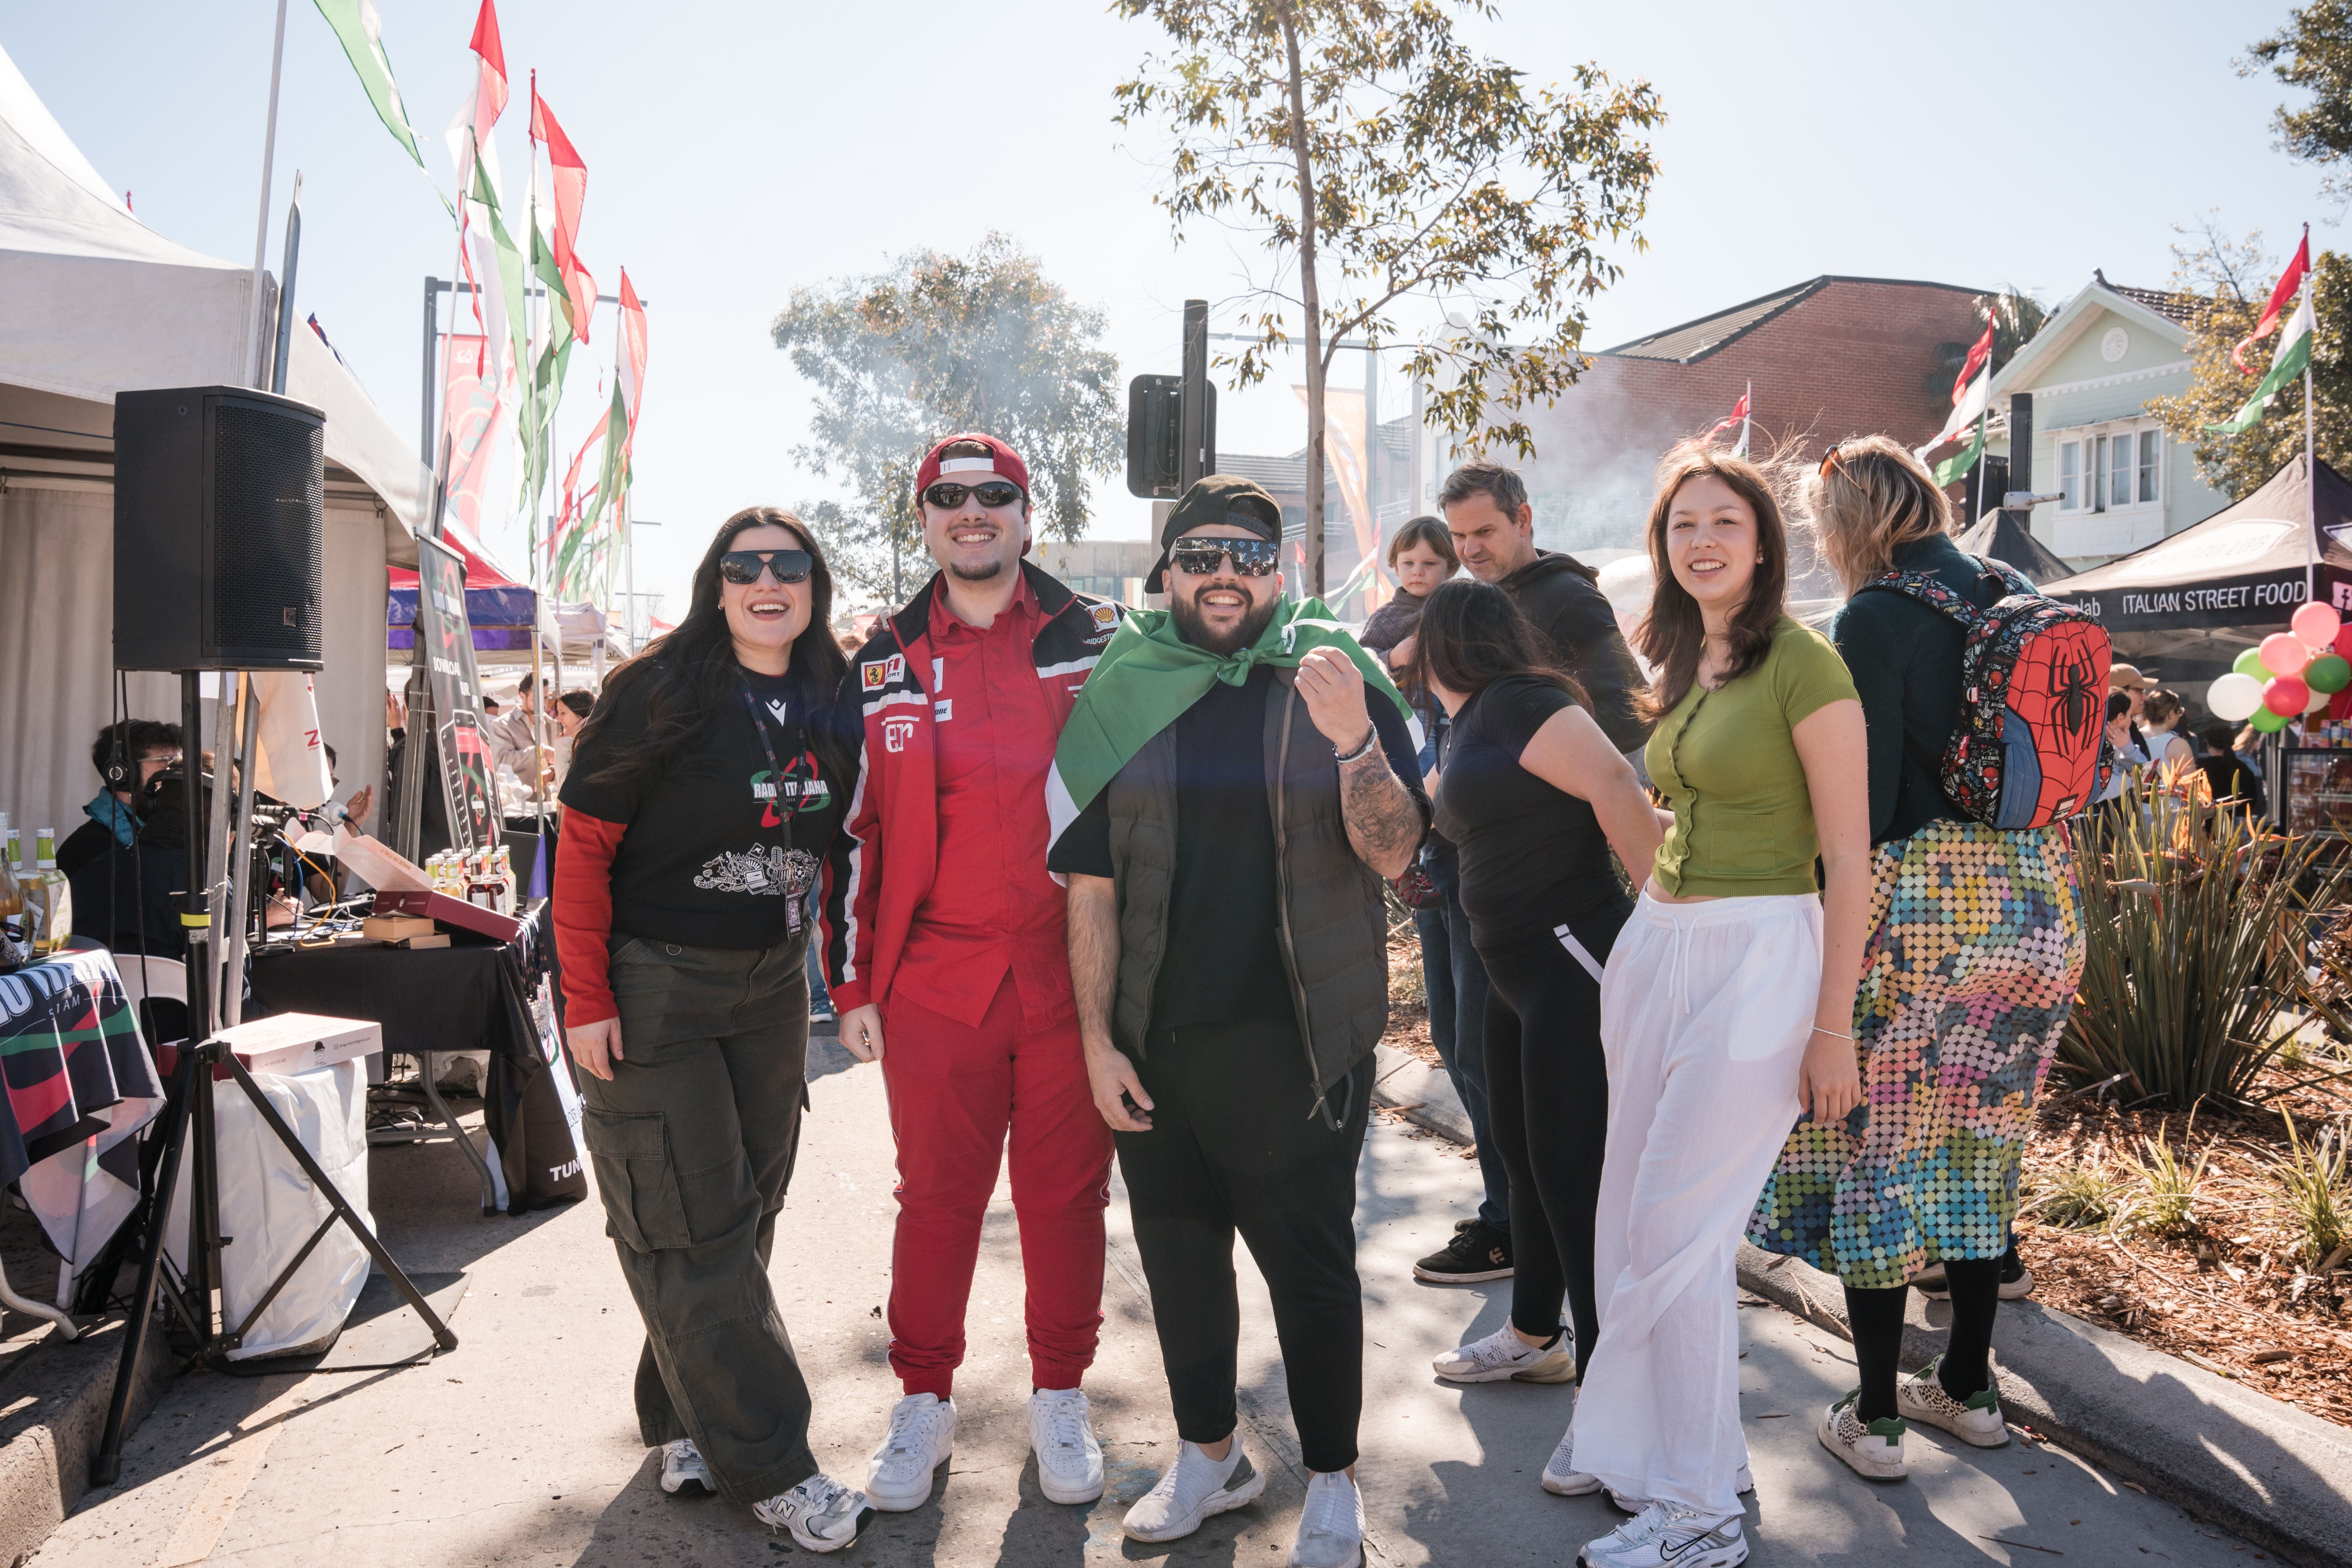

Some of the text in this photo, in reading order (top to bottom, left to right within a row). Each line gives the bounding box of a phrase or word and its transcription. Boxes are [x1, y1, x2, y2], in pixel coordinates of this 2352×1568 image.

[2123, 592, 2181, 614] ITALIAN
[2185, 586, 2250, 611] STREET
[2254, 581, 2307, 606] FOOD
[2025, 622, 2045, 631] AMAZIN
[1082, 632, 1115, 645] BRIDGESTO
[886, 672, 900, 680] ORT
[754, 780, 828, 798] RADI ITIANA
[380, 849, 392, 859] ITALY
[399, 860, 412, 870] MADE
